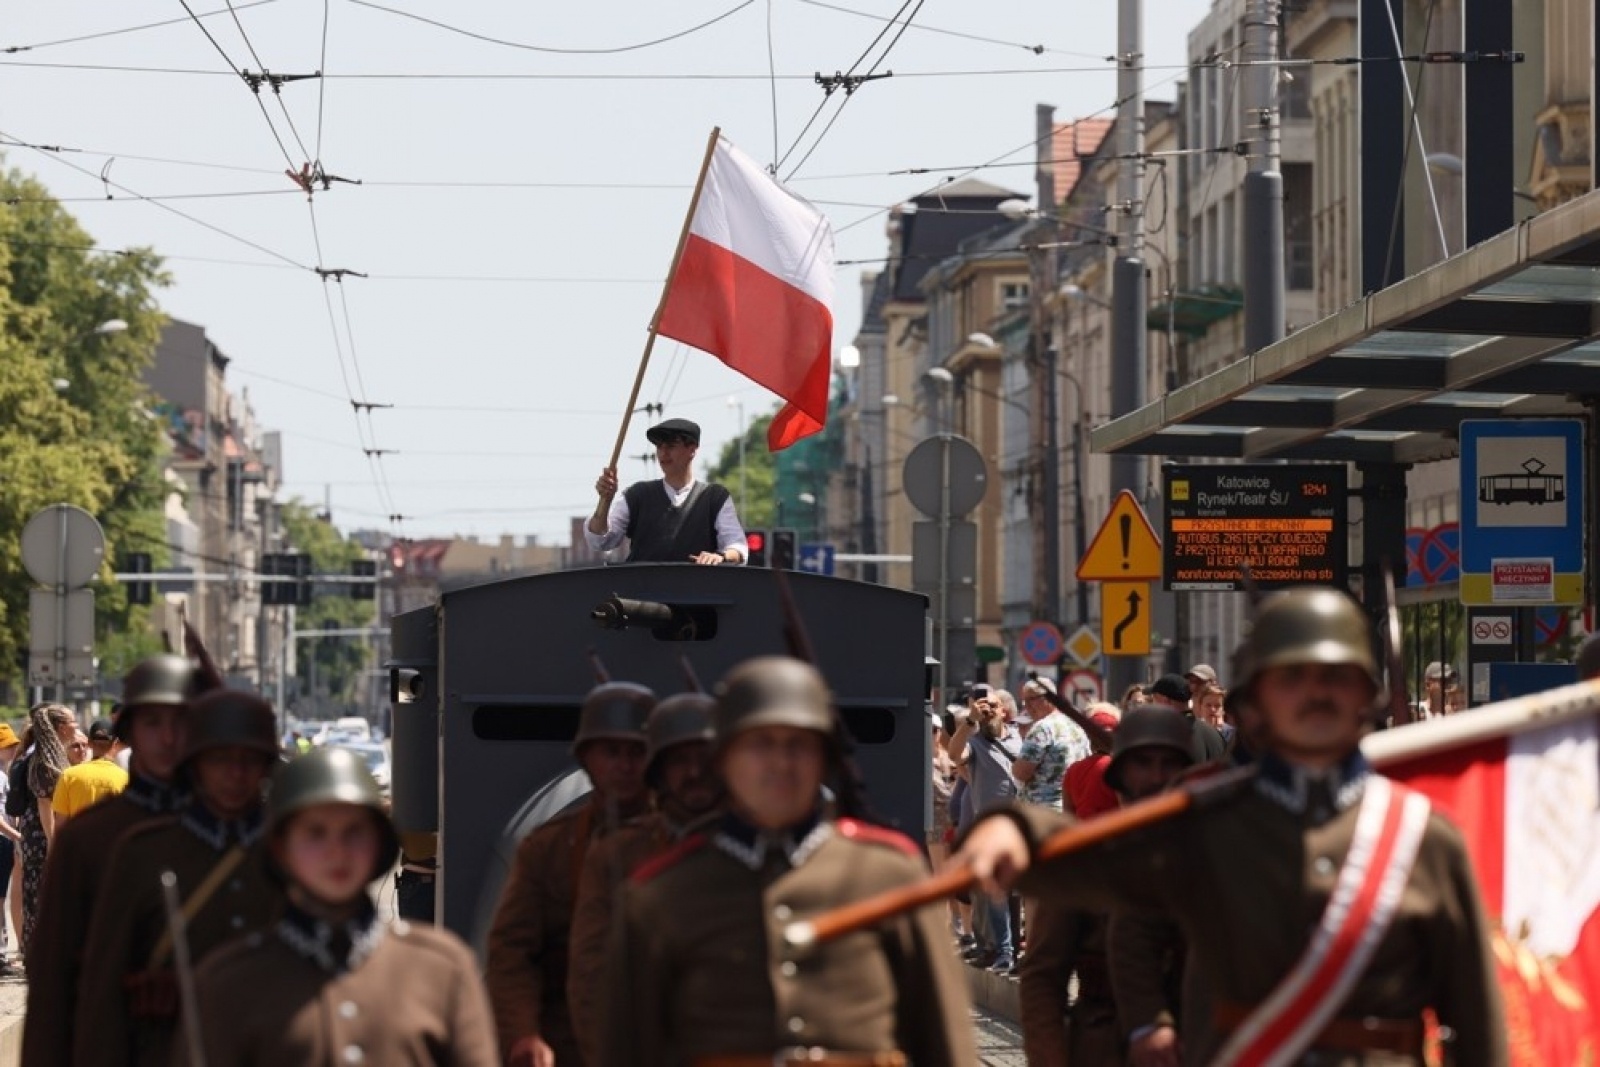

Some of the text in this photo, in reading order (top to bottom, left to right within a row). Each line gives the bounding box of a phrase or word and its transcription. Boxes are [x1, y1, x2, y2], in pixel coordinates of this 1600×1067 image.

[1217, 476, 1270, 488] Katowice
[1197, 490, 1267, 508] Rynek/Teatr
[1177, 533, 1219, 544] AUTOBUS
[1175, 544, 1183, 556] Z
[1185, 544, 1246, 556] PRZYSTANKU
[1268, 555, 1300, 567] RONDA
